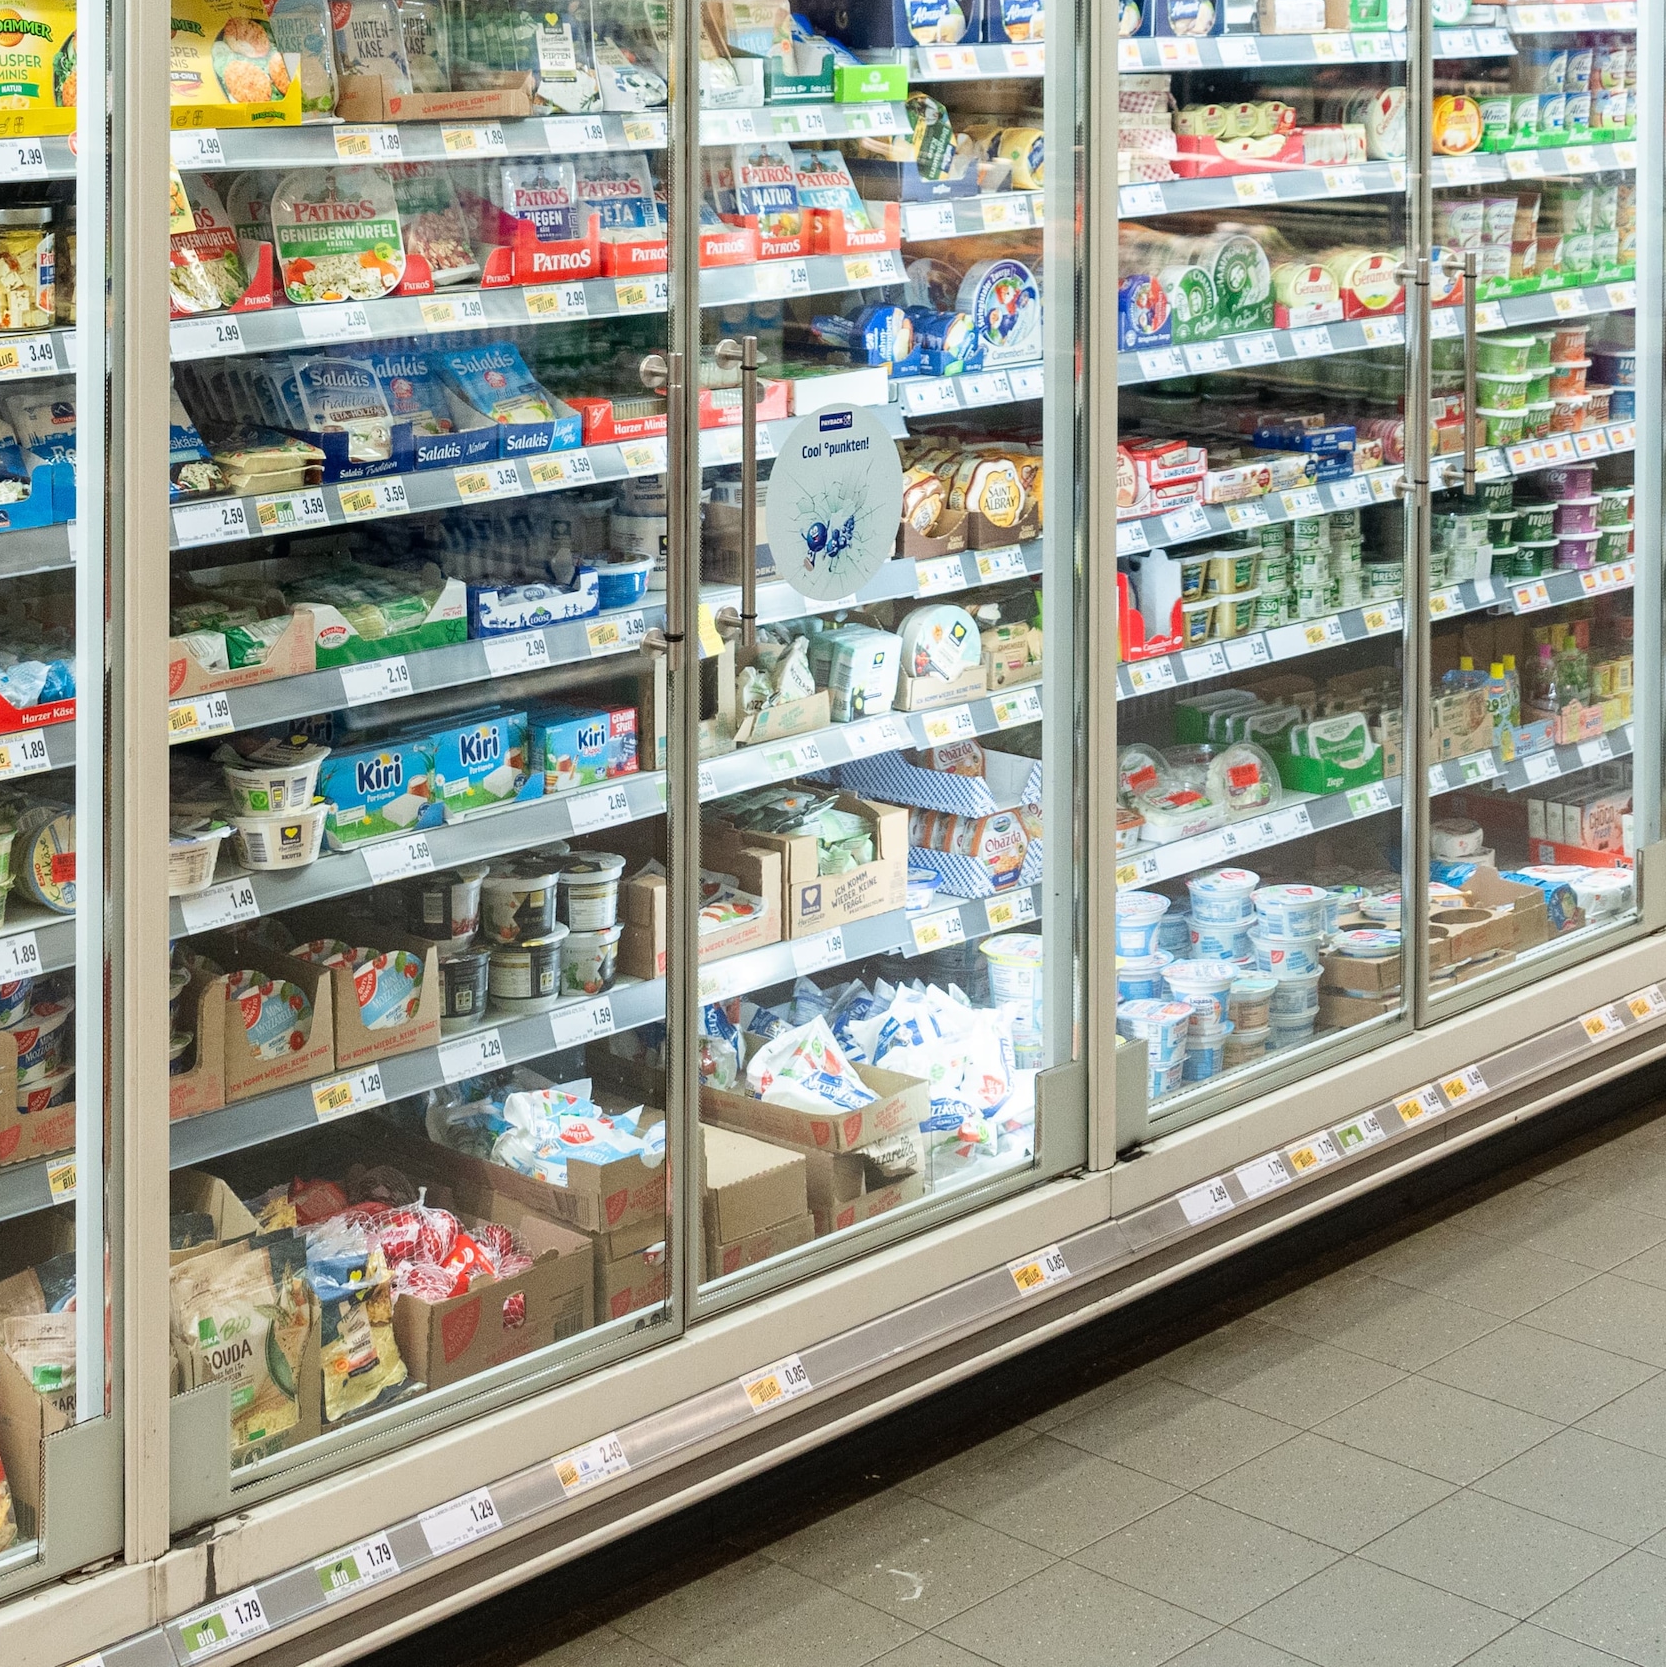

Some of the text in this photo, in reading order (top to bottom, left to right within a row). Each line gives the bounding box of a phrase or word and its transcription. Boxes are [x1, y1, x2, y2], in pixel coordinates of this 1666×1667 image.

[351, 19, 394, 41] HIRTEN-
[359, 38, 385, 57] KÄSE
[1, 84, 22, 93] NATUR
[18, 149, 43, 165] 2.99
[741, 165, 793, 183] PATROS
[751, 189, 792, 206] NATUR
[293, 201, 376, 222] PATROS
[525, 210, 563, 226] ZIEGEN
[533, 249, 591, 271] PATROS
[451, 351, 514, 373] Salakis
[310, 369, 370, 388] Salakis
[821, 417, 844, 428] PAYBACK
[418, 443, 462, 464] Salakis
[802, 444, 822, 459] Cool
[1163, 462, 1198, 476] LIMBURGER
[384, 486, 405, 502] 3.59
[988, 485, 1012, 498] SAINT
[984, 493, 1017, 511] ALBRAY
[22, 707, 75, 724] Harzer Käse
[458, 727, 499, 765] Kiri
[357, 760, 402, 793] Kiri
[984, 830, 1022, 852] Obazda
[234, 1601, 262, 1624] 1.79
